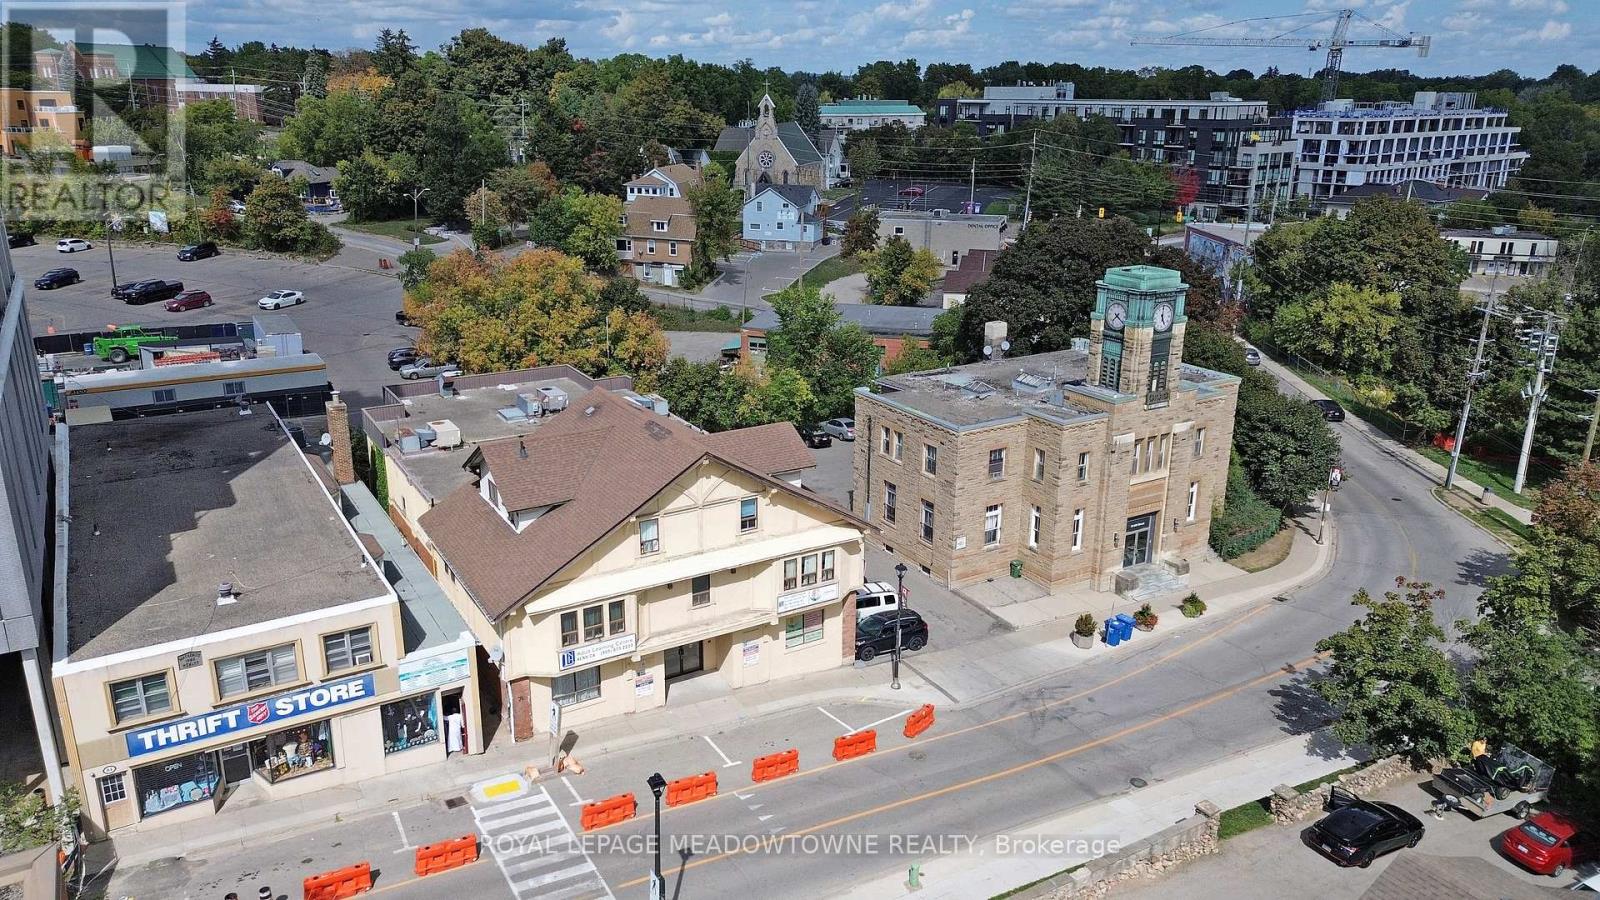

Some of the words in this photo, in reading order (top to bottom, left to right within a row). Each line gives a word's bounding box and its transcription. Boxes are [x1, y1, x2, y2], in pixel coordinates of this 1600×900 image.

[138, 709, 241, 750] THRIFT
[275, 679, 367, 716] STORE
[164, 762, 182, 772] OPEN
